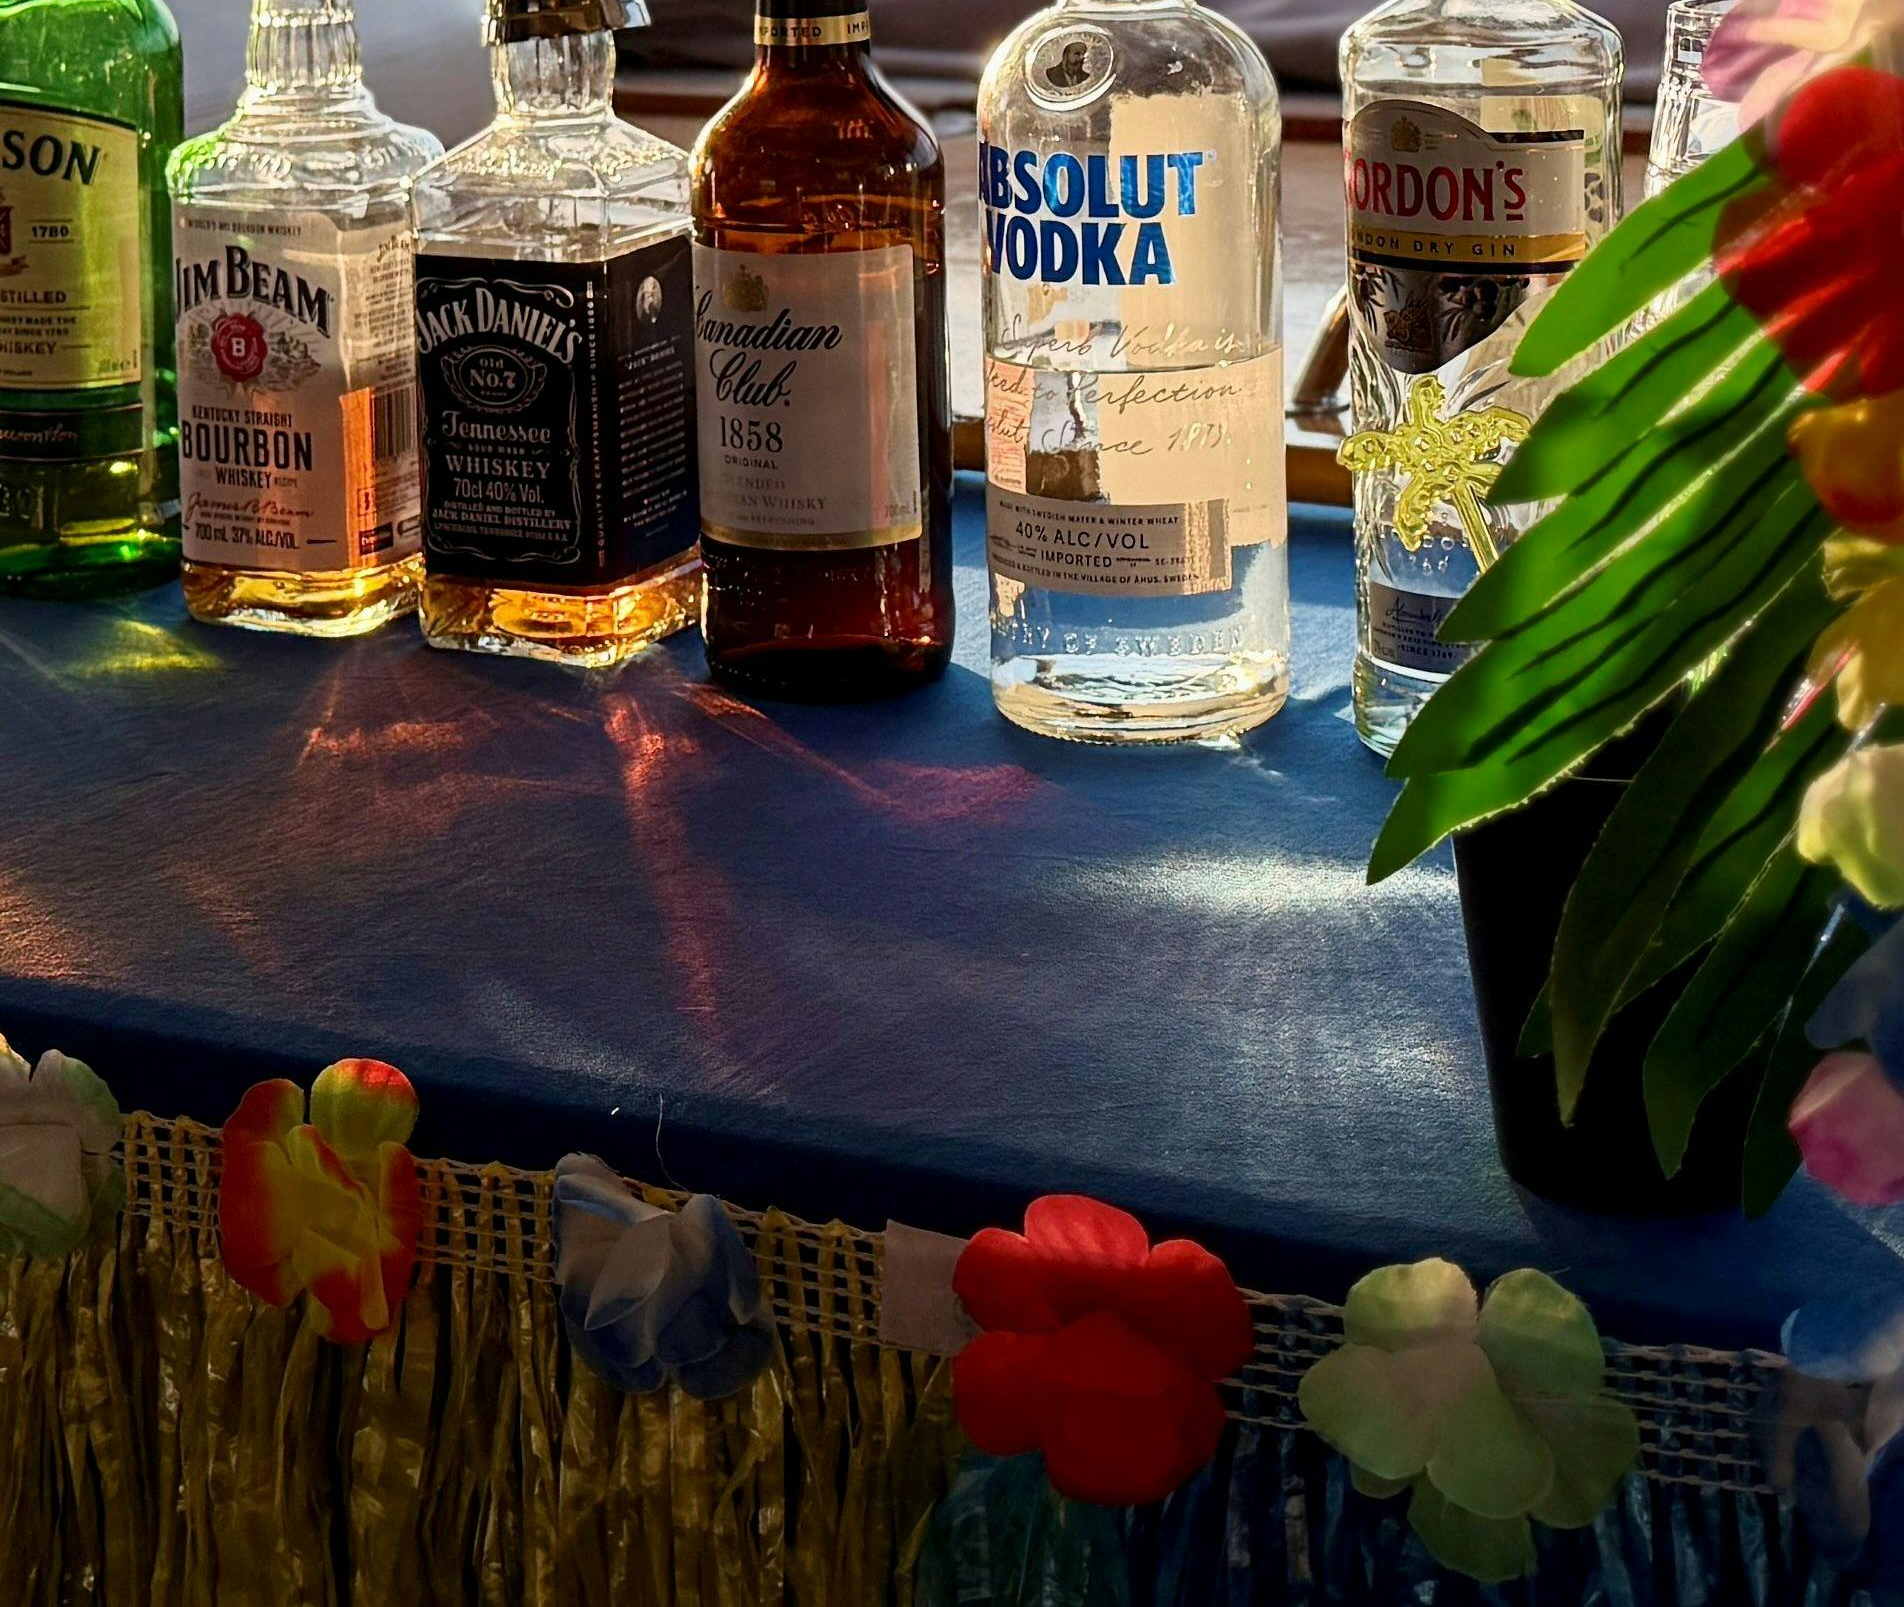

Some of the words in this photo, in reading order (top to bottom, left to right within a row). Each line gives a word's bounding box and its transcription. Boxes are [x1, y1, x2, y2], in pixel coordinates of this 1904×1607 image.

[31, 225, 69, 239] 1780
[986, 208, 1172, 286] VODKA
[1413, 239, 1454, 255] DRY
[1472, 244, 1516, 257] GIN
[175, 257, 221, 324] JIM
[225, 245, 331, 339] BEAM
[416, 299, 475, 354] JACK
[475, 287, 584, 364] DANIEL'S
[696, 289, 844, 351] Canadian
[1110, 322, 1208, 359] Vodka
[192, 405, 240, 423] KENTUCKY
[244, 410, 292, 428] STRAIGHT
[441, 410, 552, 444] Tennessee
[181, 420, 313, 471] BOURBON
[720, 416, 783, 453] 1858
[445, 454, 552, 479] WHISKEY
[724, 454, 779, 470] ORIGINAL
[216, 466, 272, 489] WHISKEY
[453, 477, 483, 499] 70cl
[485, 480, 517, 503] 40%
[519, 483, 545, 504] Vol.
[762, 495, 827, 511] WHISKY
[461, 511, 502, 524] DANIEL
[1107, 518, 1144, 526] WINTER
[1146, 516, 1179, 525] WHEAT
[1016, 521, 1048, 543] 40%
[1041, 550, 1112, 568] IMPORTED
[1063, 572, 1079, 582] THE
[1081, 574, 1117, 583] VILLAGE
[1119, 575, 1132, 584] OF
